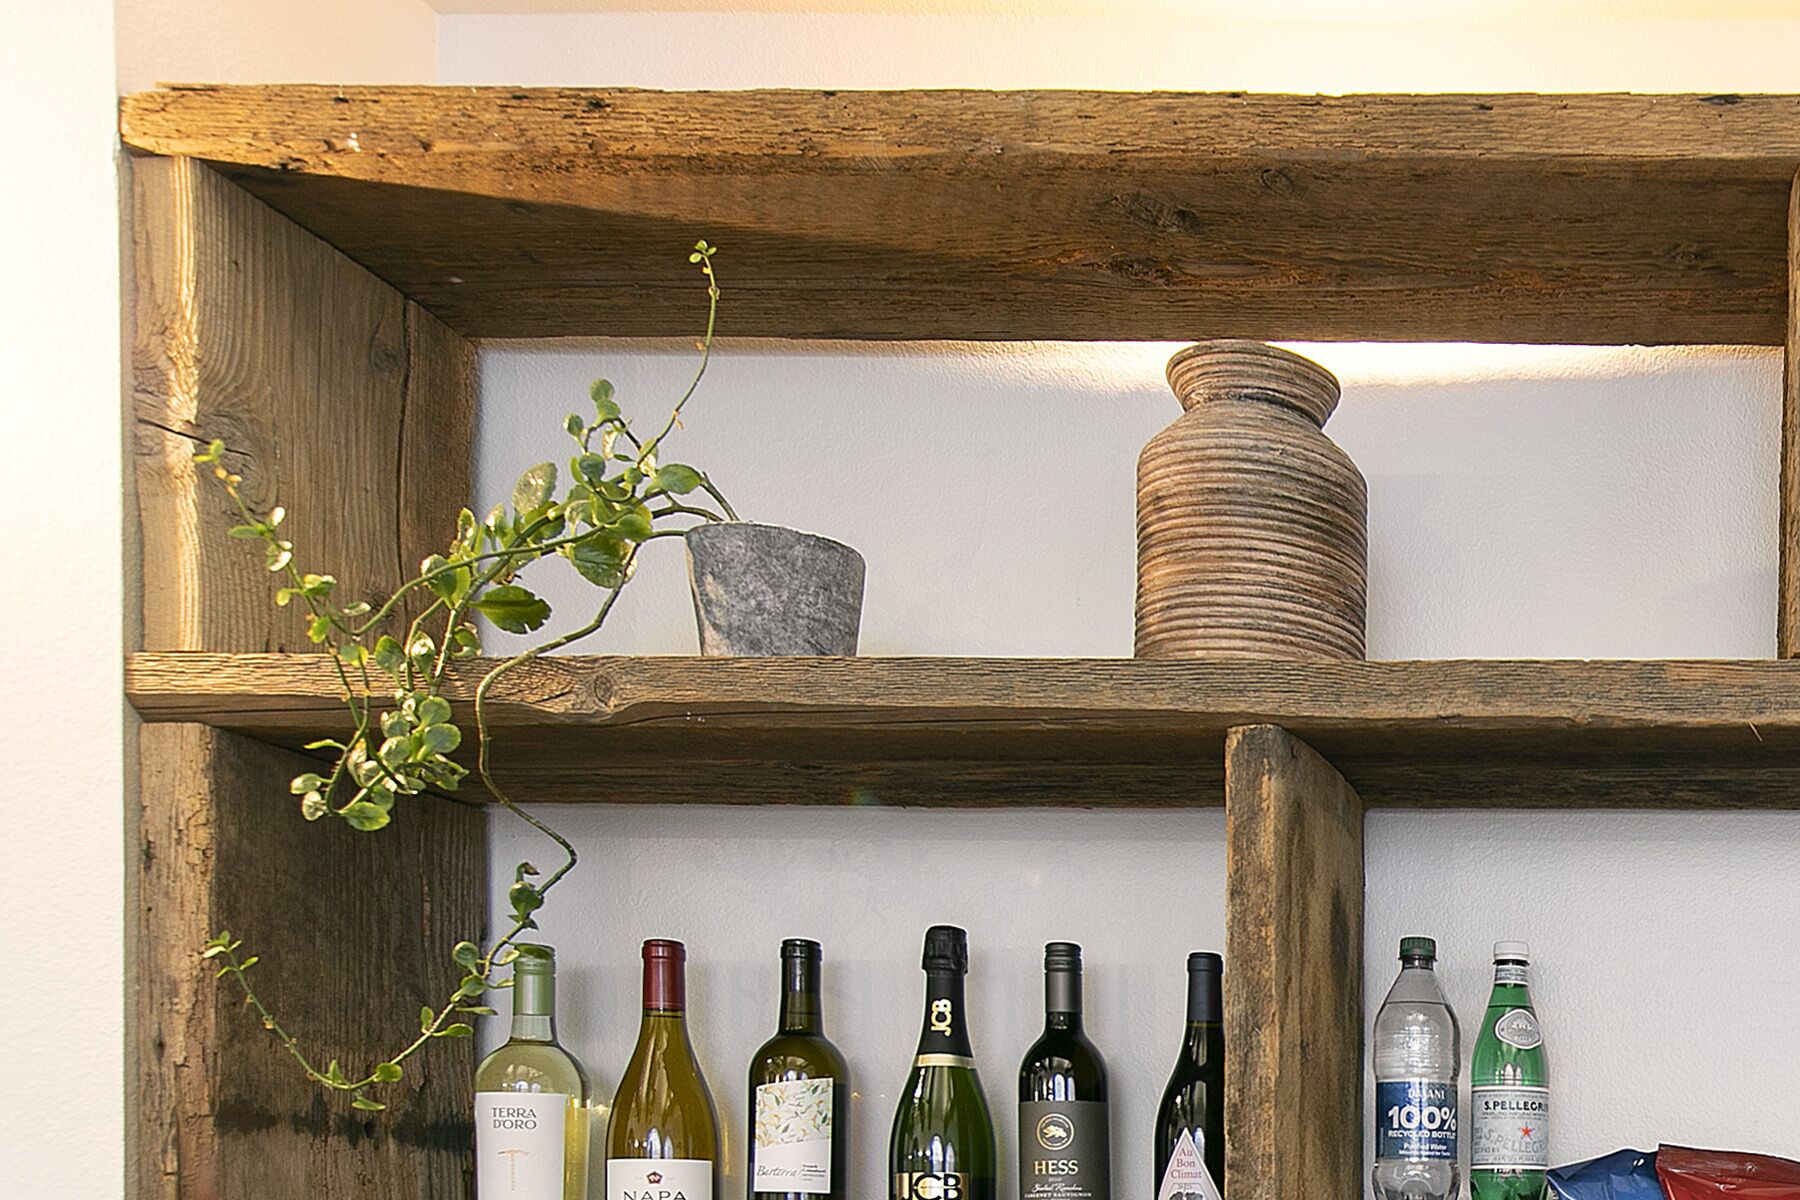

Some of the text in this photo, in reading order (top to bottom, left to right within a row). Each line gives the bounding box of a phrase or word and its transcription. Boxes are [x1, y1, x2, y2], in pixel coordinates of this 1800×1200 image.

[930, 998, 952, 1037] JCB
[492, 1107, 537, 1118] TERRA
[1388, 1105, 1457, 1131] 100%
[493, 1119, 537, 1129] D'ORO
[1388, 1130, 1430, 1138] RECYCLED
[1179, 1148, 1193, 1157] Au
[1034, 1160, 1079, 1175] HESS
[1176, 1159, 1196, 1168] Bon
[1170, 1170, 1202, 1179] Climat
